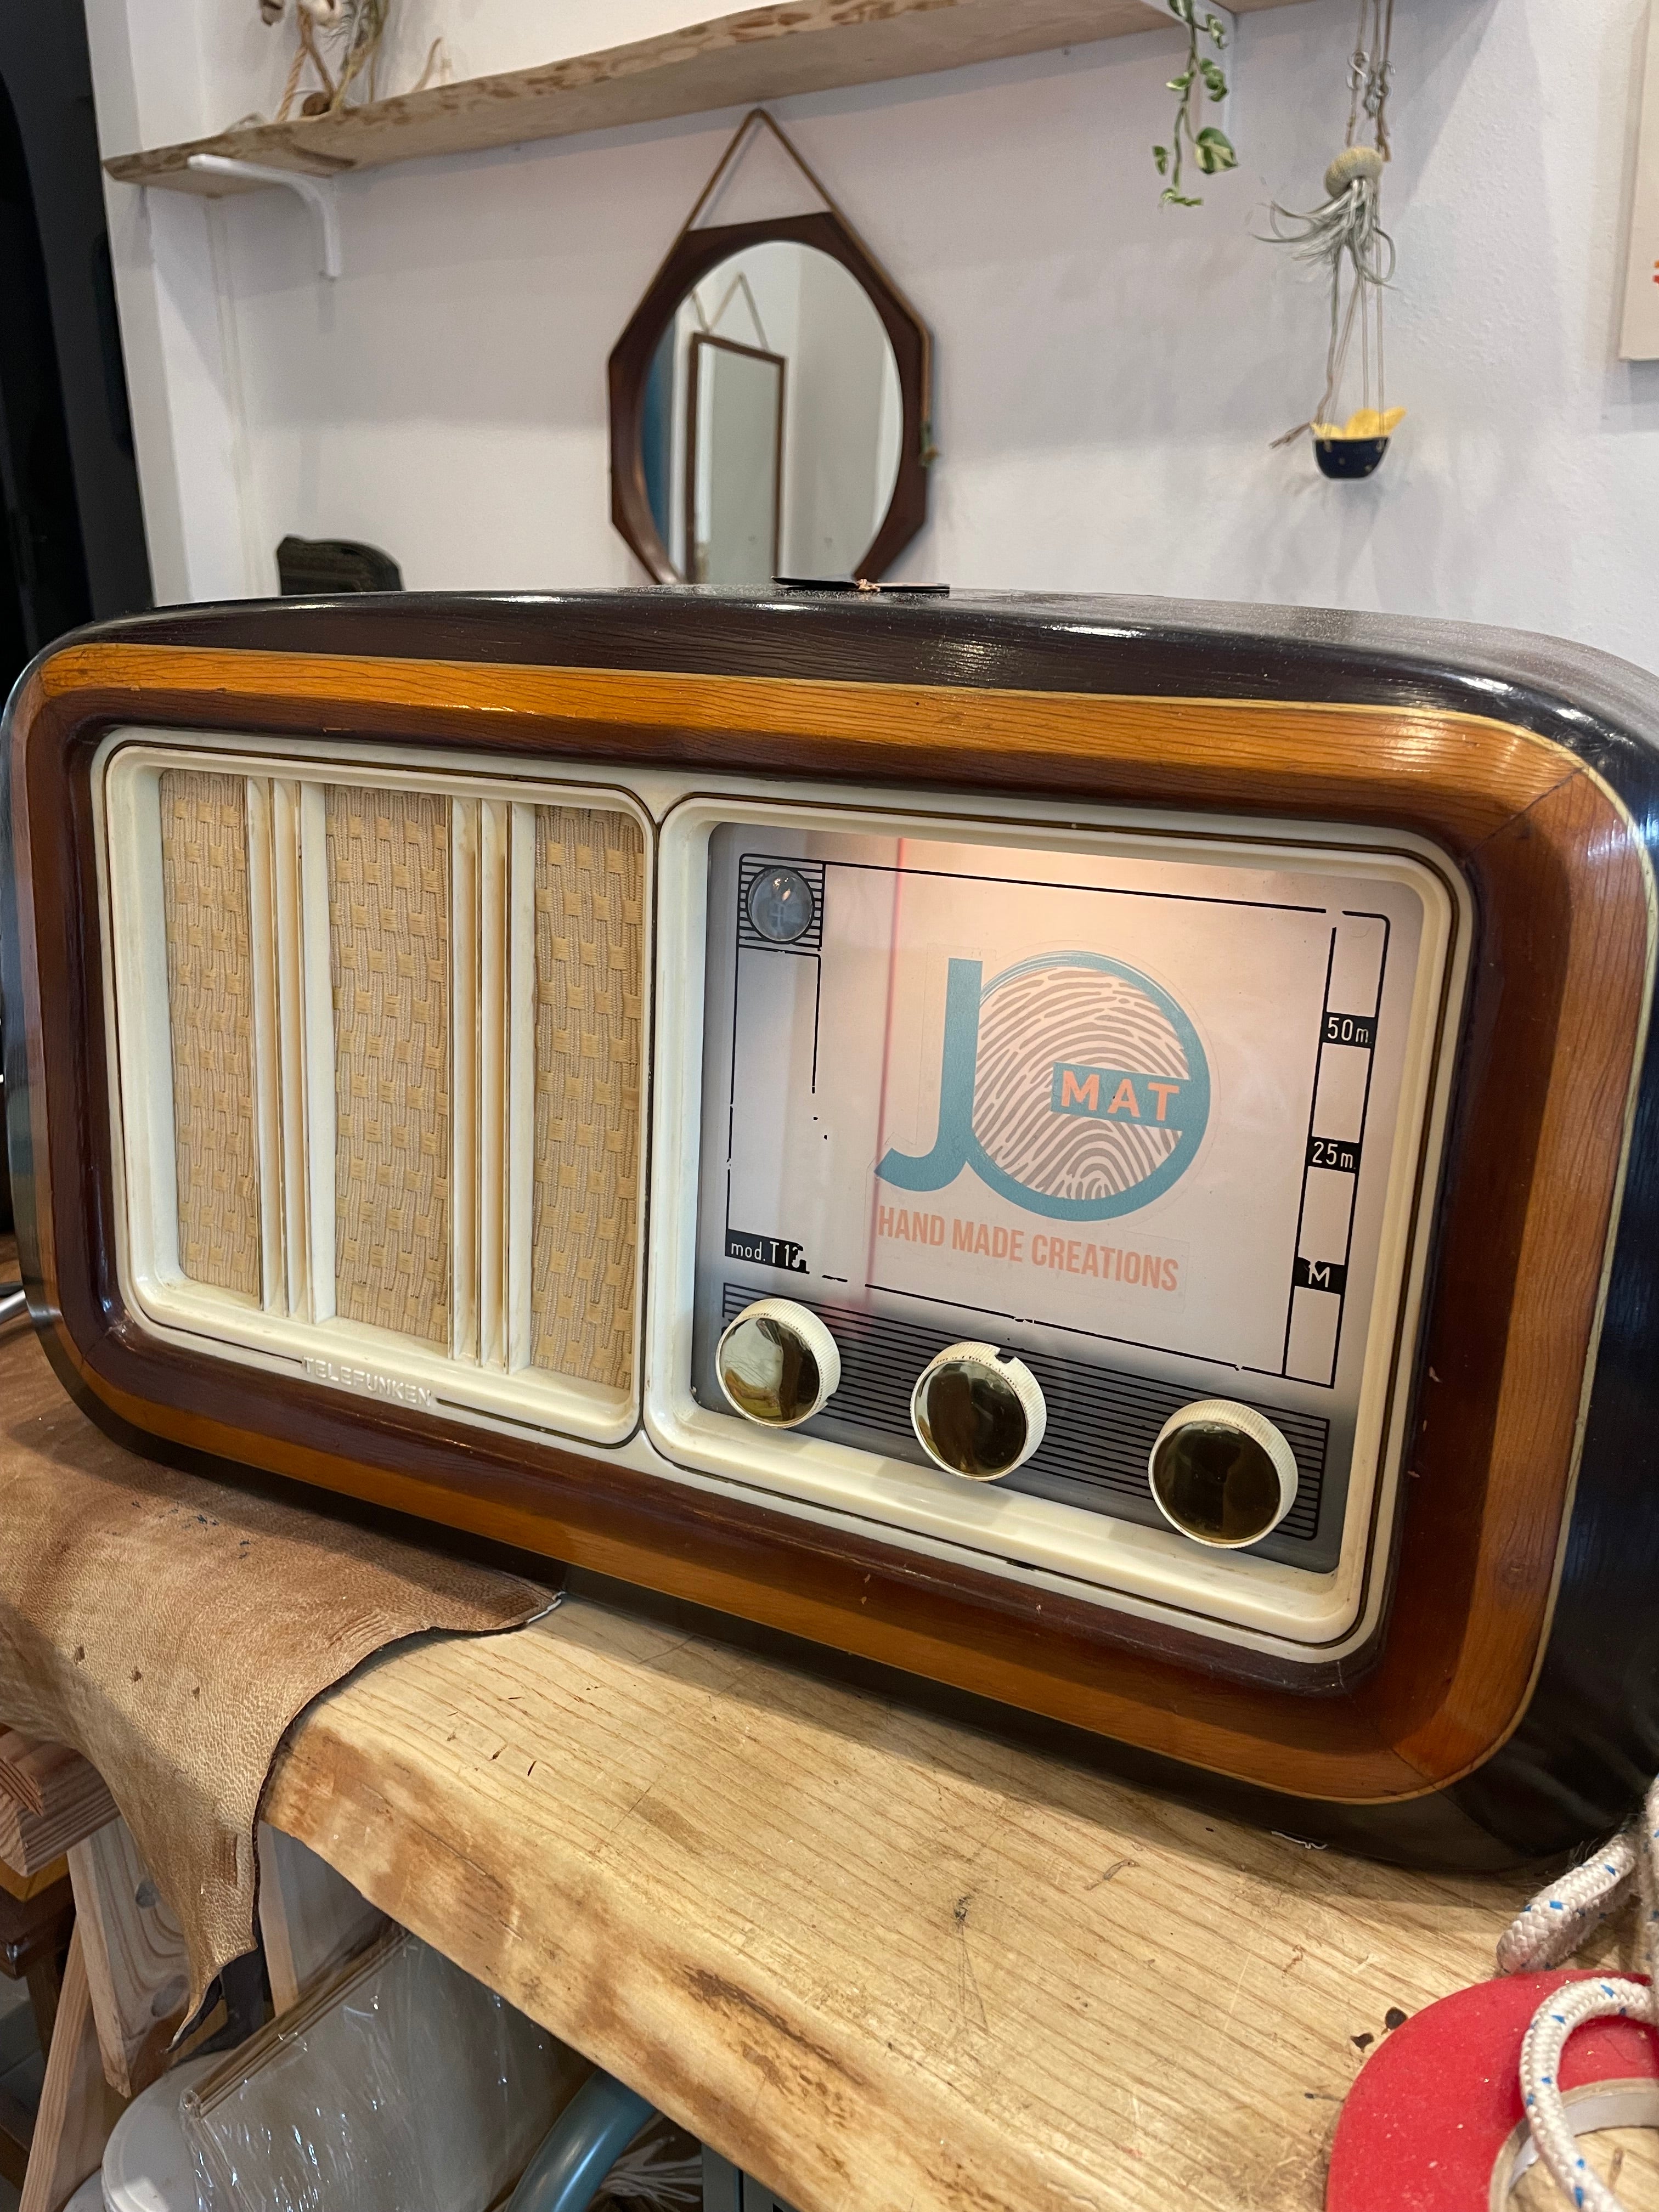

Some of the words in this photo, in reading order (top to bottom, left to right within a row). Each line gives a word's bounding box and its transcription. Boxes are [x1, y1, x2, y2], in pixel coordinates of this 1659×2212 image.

[1061, 1070, 1180, 1122] MAT
[731, 1241, 766, 1262] mod.
[878, 1206, 945, 1246] HAND
[952, 1219, 1024, 1262] MADE
[1031, 1234, 1179, 1292] CREATIONS
[1308, 1263, 1330, 1288] M
[303, 1357, 431, 1407] TELEFUNKEN
